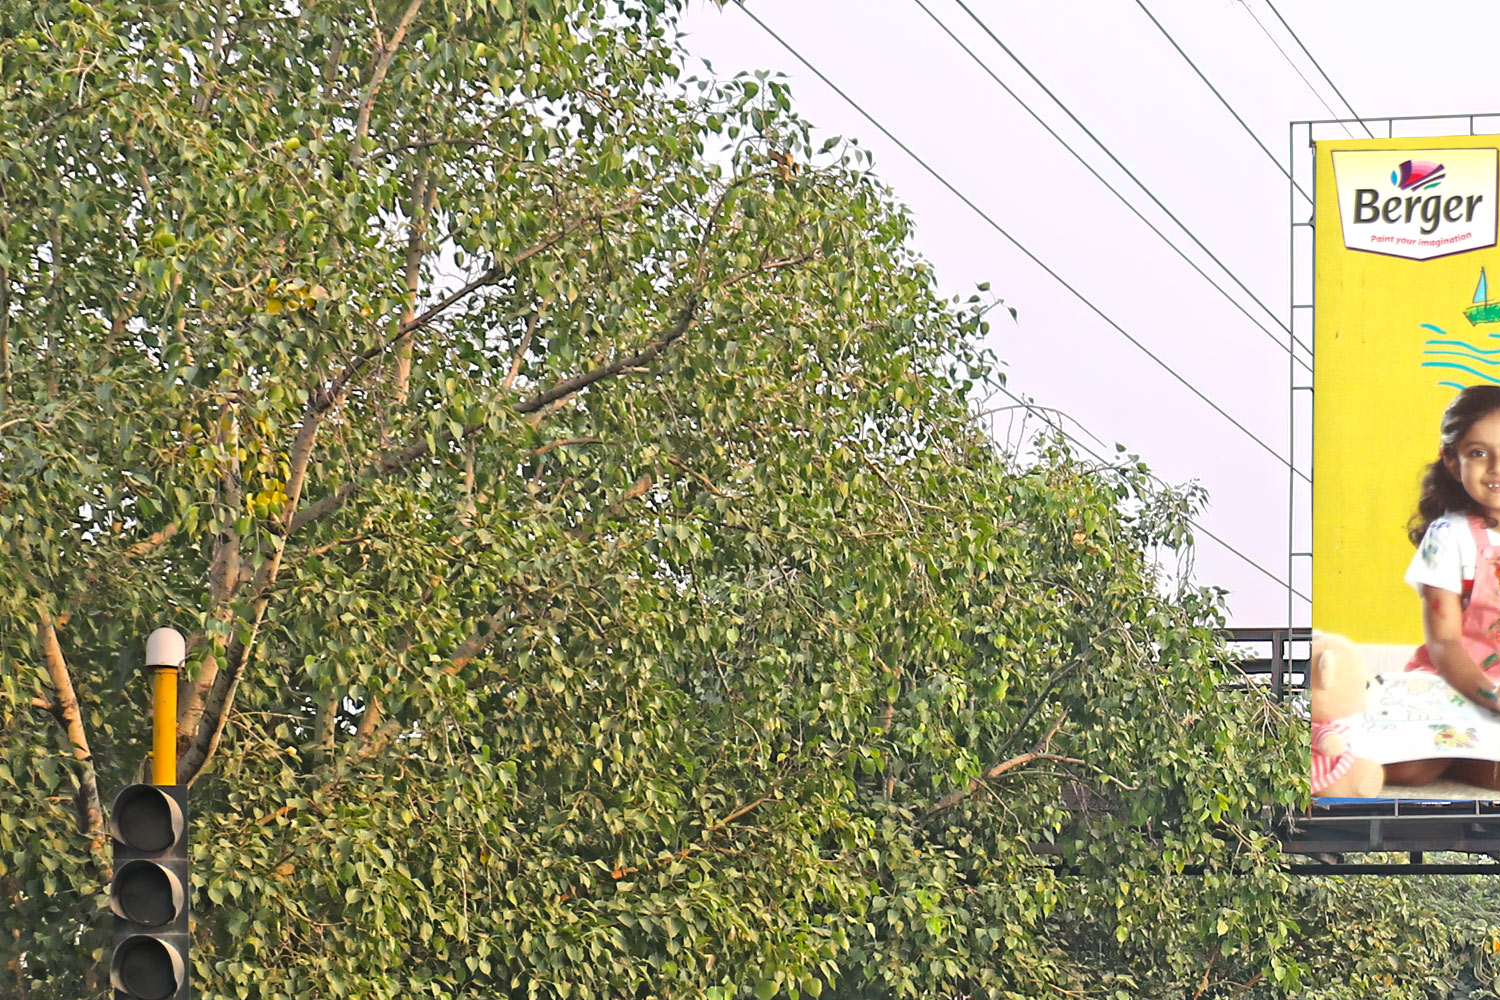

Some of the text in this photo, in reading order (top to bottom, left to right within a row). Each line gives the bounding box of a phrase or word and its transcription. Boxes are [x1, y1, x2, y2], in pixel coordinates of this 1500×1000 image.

[1353, 188, 1483, 235] Berger
[1370, 232, 1472, 248] Paint your imagination
